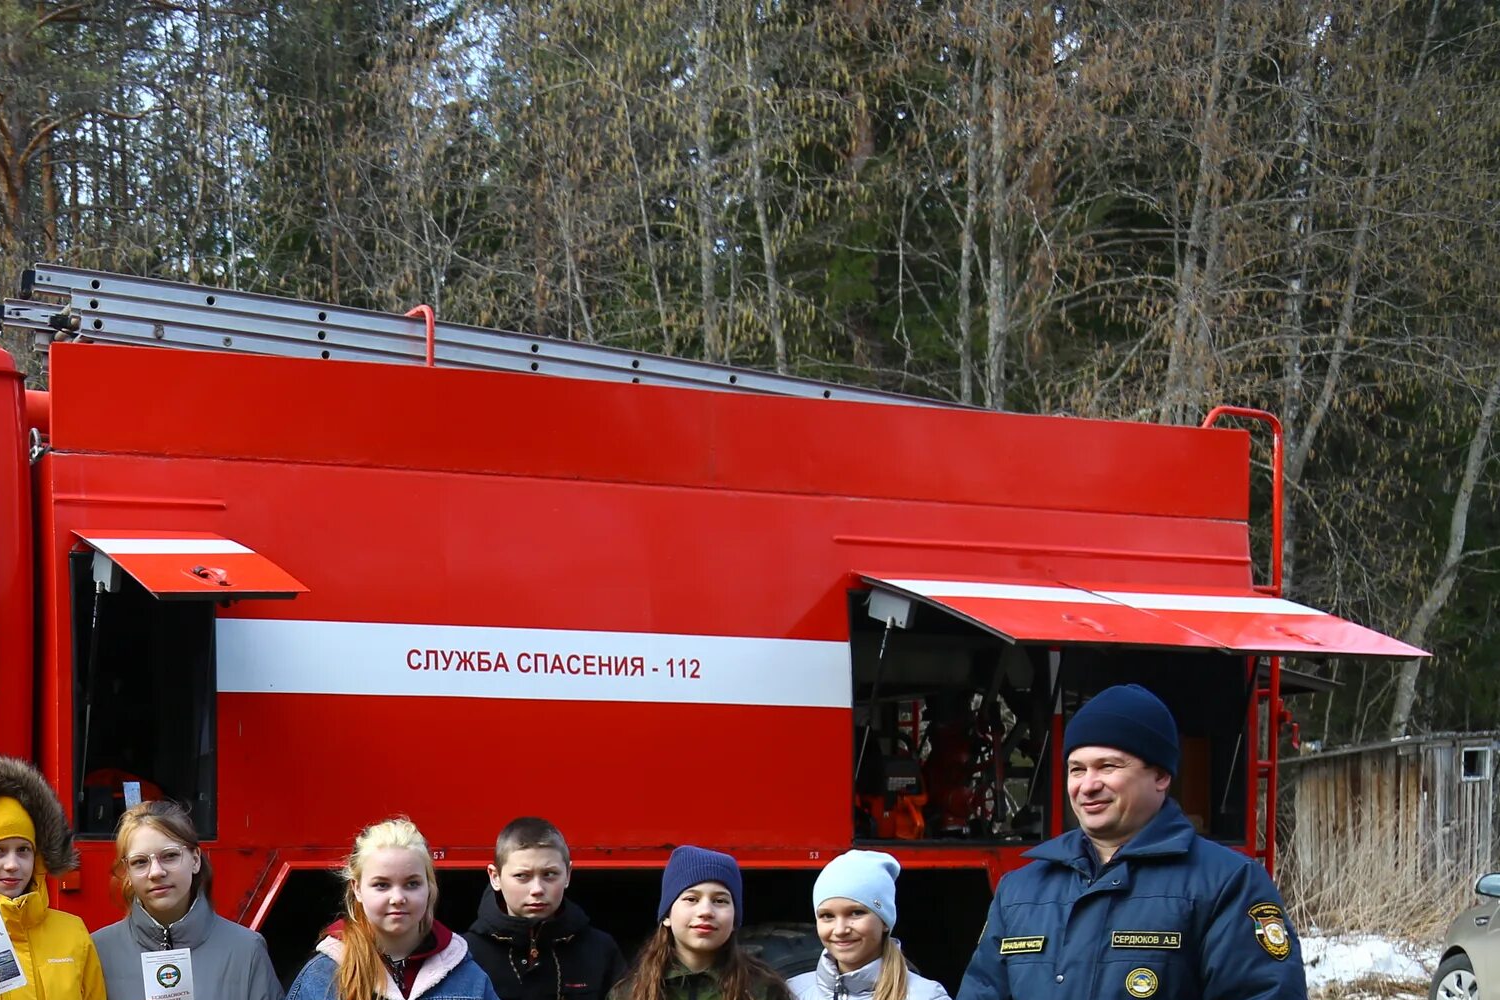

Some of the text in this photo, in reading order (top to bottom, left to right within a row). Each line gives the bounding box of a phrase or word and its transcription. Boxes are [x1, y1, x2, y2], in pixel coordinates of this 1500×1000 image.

[406, 648, 510, 672] СЛУЖБА
[516, 652, 645, 676] СПАСЕНИЯ
[666, 658, 701, 679] 112
[1114, 935, 1159, 944] СЕРДЮКОВ
